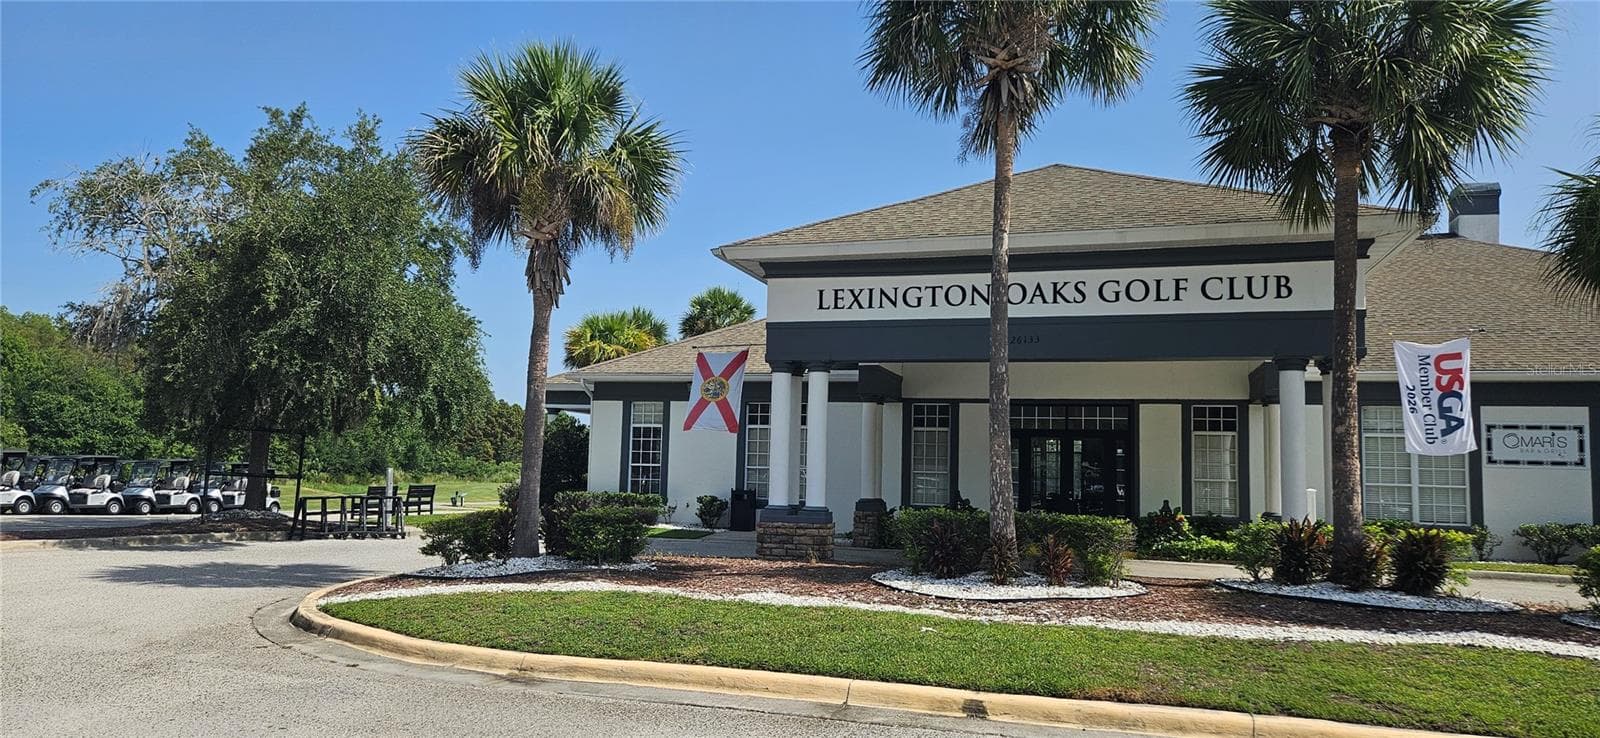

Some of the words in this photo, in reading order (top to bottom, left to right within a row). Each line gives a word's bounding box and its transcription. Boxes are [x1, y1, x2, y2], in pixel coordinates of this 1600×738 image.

[817, 283, 991, 310] LEXINGTON
[1007, 281, 1087, 305] OAKS
[1098, 278, 1189, 303] GOLF
[1200, 275, 1293, 300] CLUB
[1008, 335, 1040, 345] 26133
[1417, 354, 1434, 411] Member
[1405, 384, 1418, 414] 2026
[1422, 413, 1439, 445] Club
